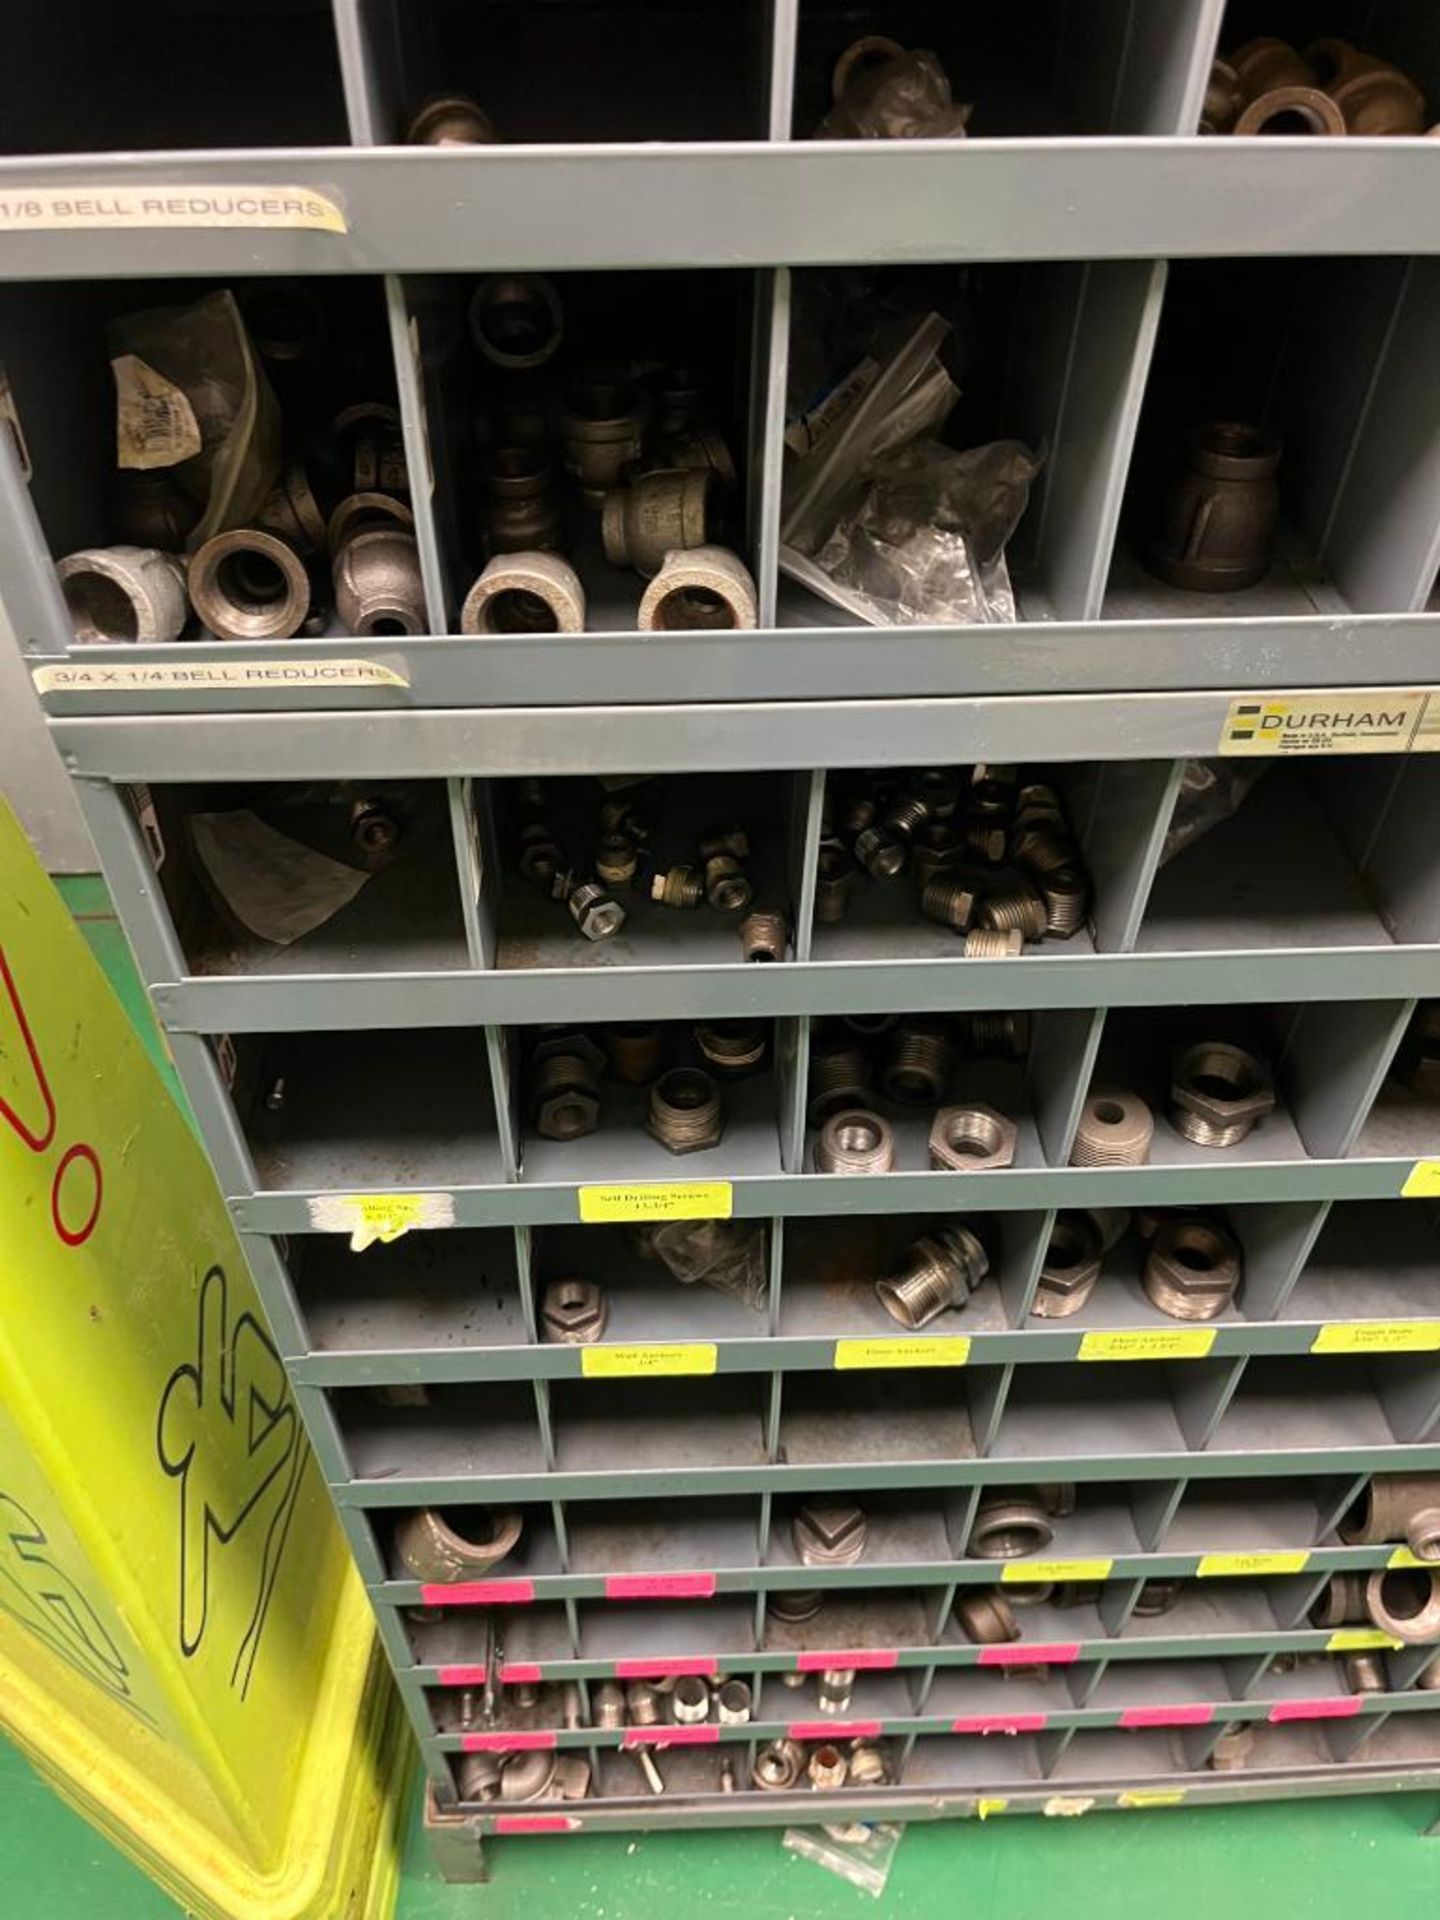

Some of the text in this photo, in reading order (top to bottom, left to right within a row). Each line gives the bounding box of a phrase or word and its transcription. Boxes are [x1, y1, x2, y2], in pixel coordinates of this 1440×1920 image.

[51, 199, 135, 216] BELL
[142, 199, 326, 217] REDUCERS
[54, 667, 392, 683] 3/4 X 1/4 BELL REDUCERS
[1261, 711, 1407, 730] DURHAM
